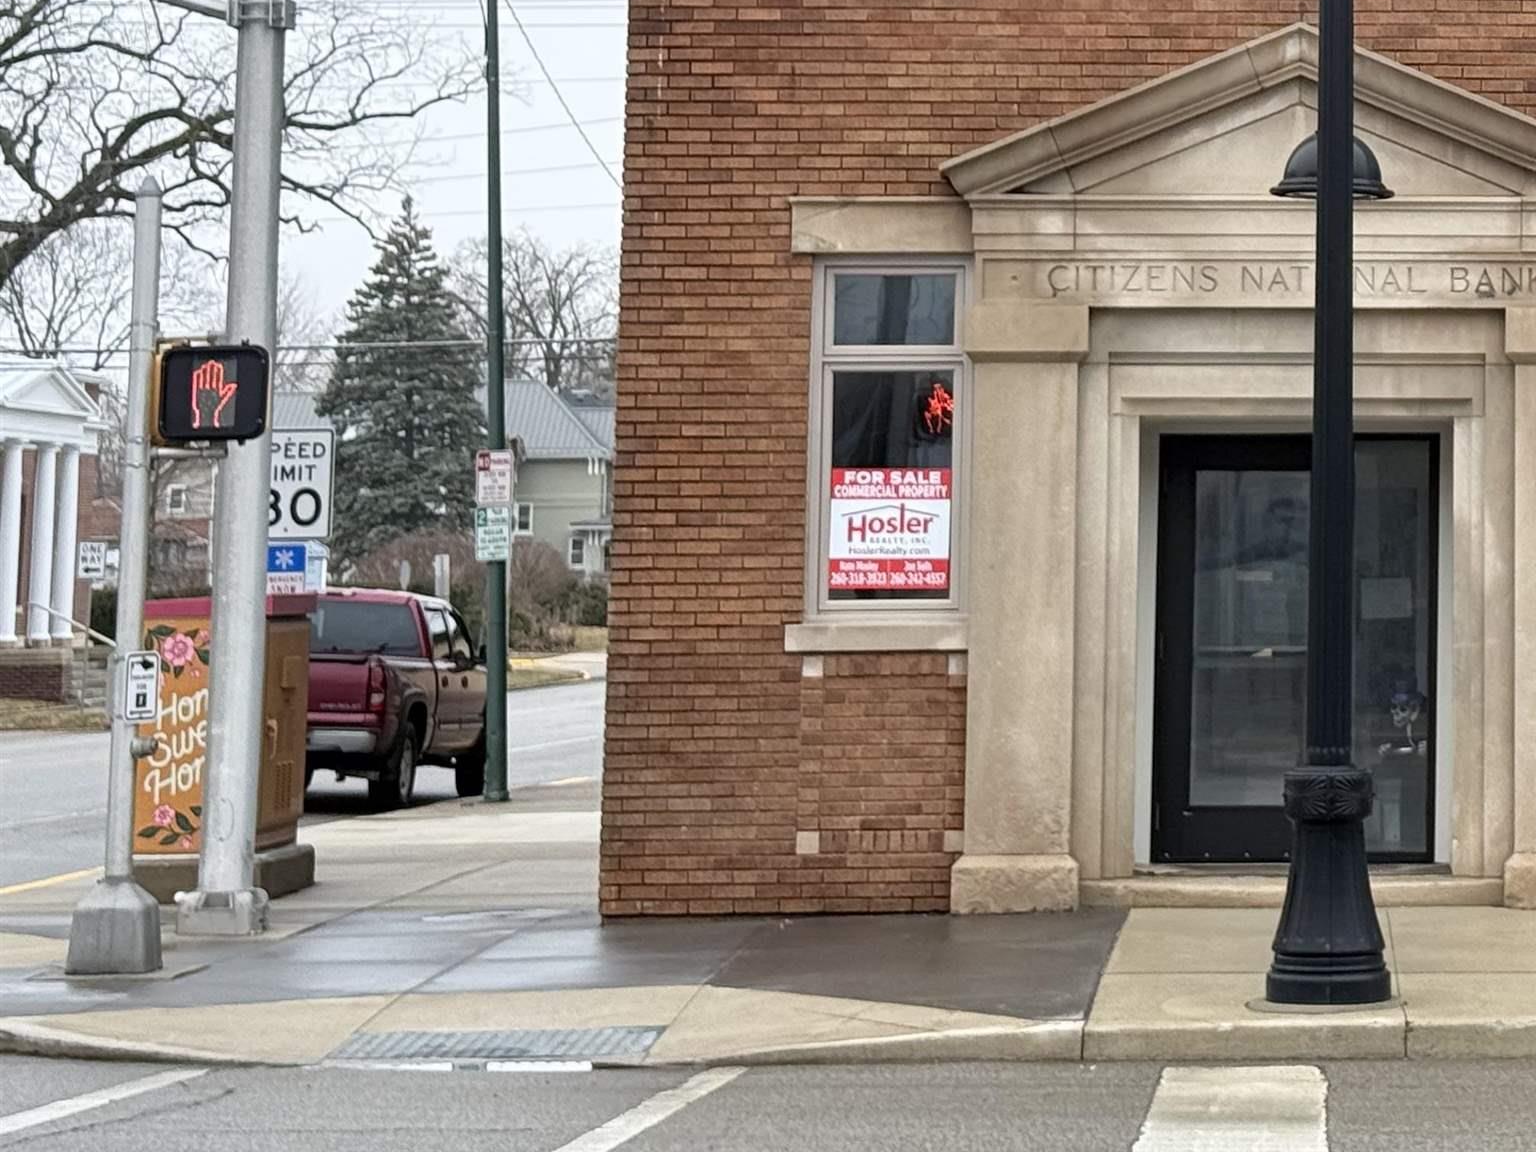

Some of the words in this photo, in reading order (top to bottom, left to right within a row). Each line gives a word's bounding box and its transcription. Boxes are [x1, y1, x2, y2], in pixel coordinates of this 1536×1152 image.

[1047, 265, 1219, 294] CITIZENS
[1241, 265, 1427, 294] NATNAL
[271, 442, 326, 459] PEED
[273, 464, 317, 481] IMIT
[844, 471, 885, 484] FOR
[890, 471, 941, 484] SALE
[834, 485, 897, 497] COMMERCIAL
[899, 485, 948, 497] PROPERTY
[847, 503, 933, 543] Hosler
